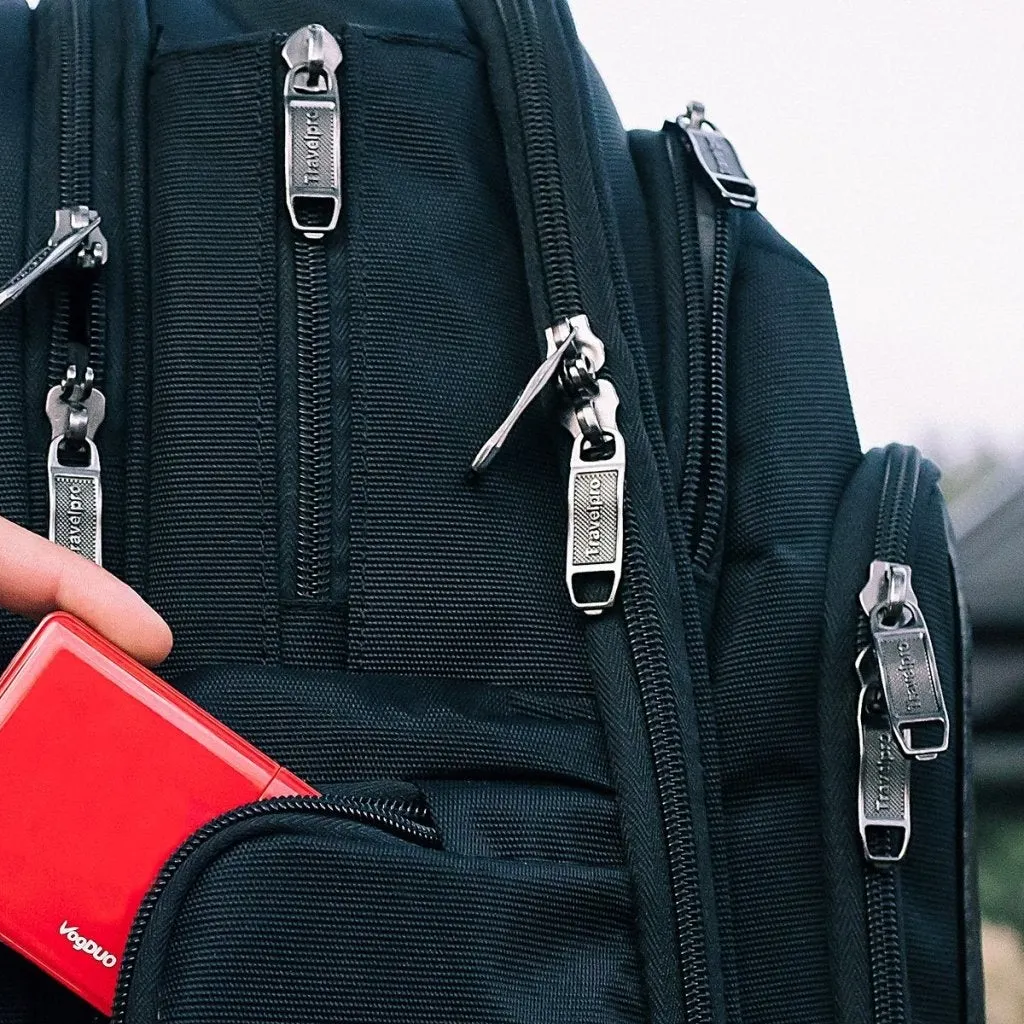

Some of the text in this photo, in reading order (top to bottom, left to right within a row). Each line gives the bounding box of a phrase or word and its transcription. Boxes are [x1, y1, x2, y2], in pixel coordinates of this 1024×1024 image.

[304, 110, 321, 184] Travelpro
[67, 484, 83, 551] ravelpro
[586, 478, 603, 556] Travelpro
